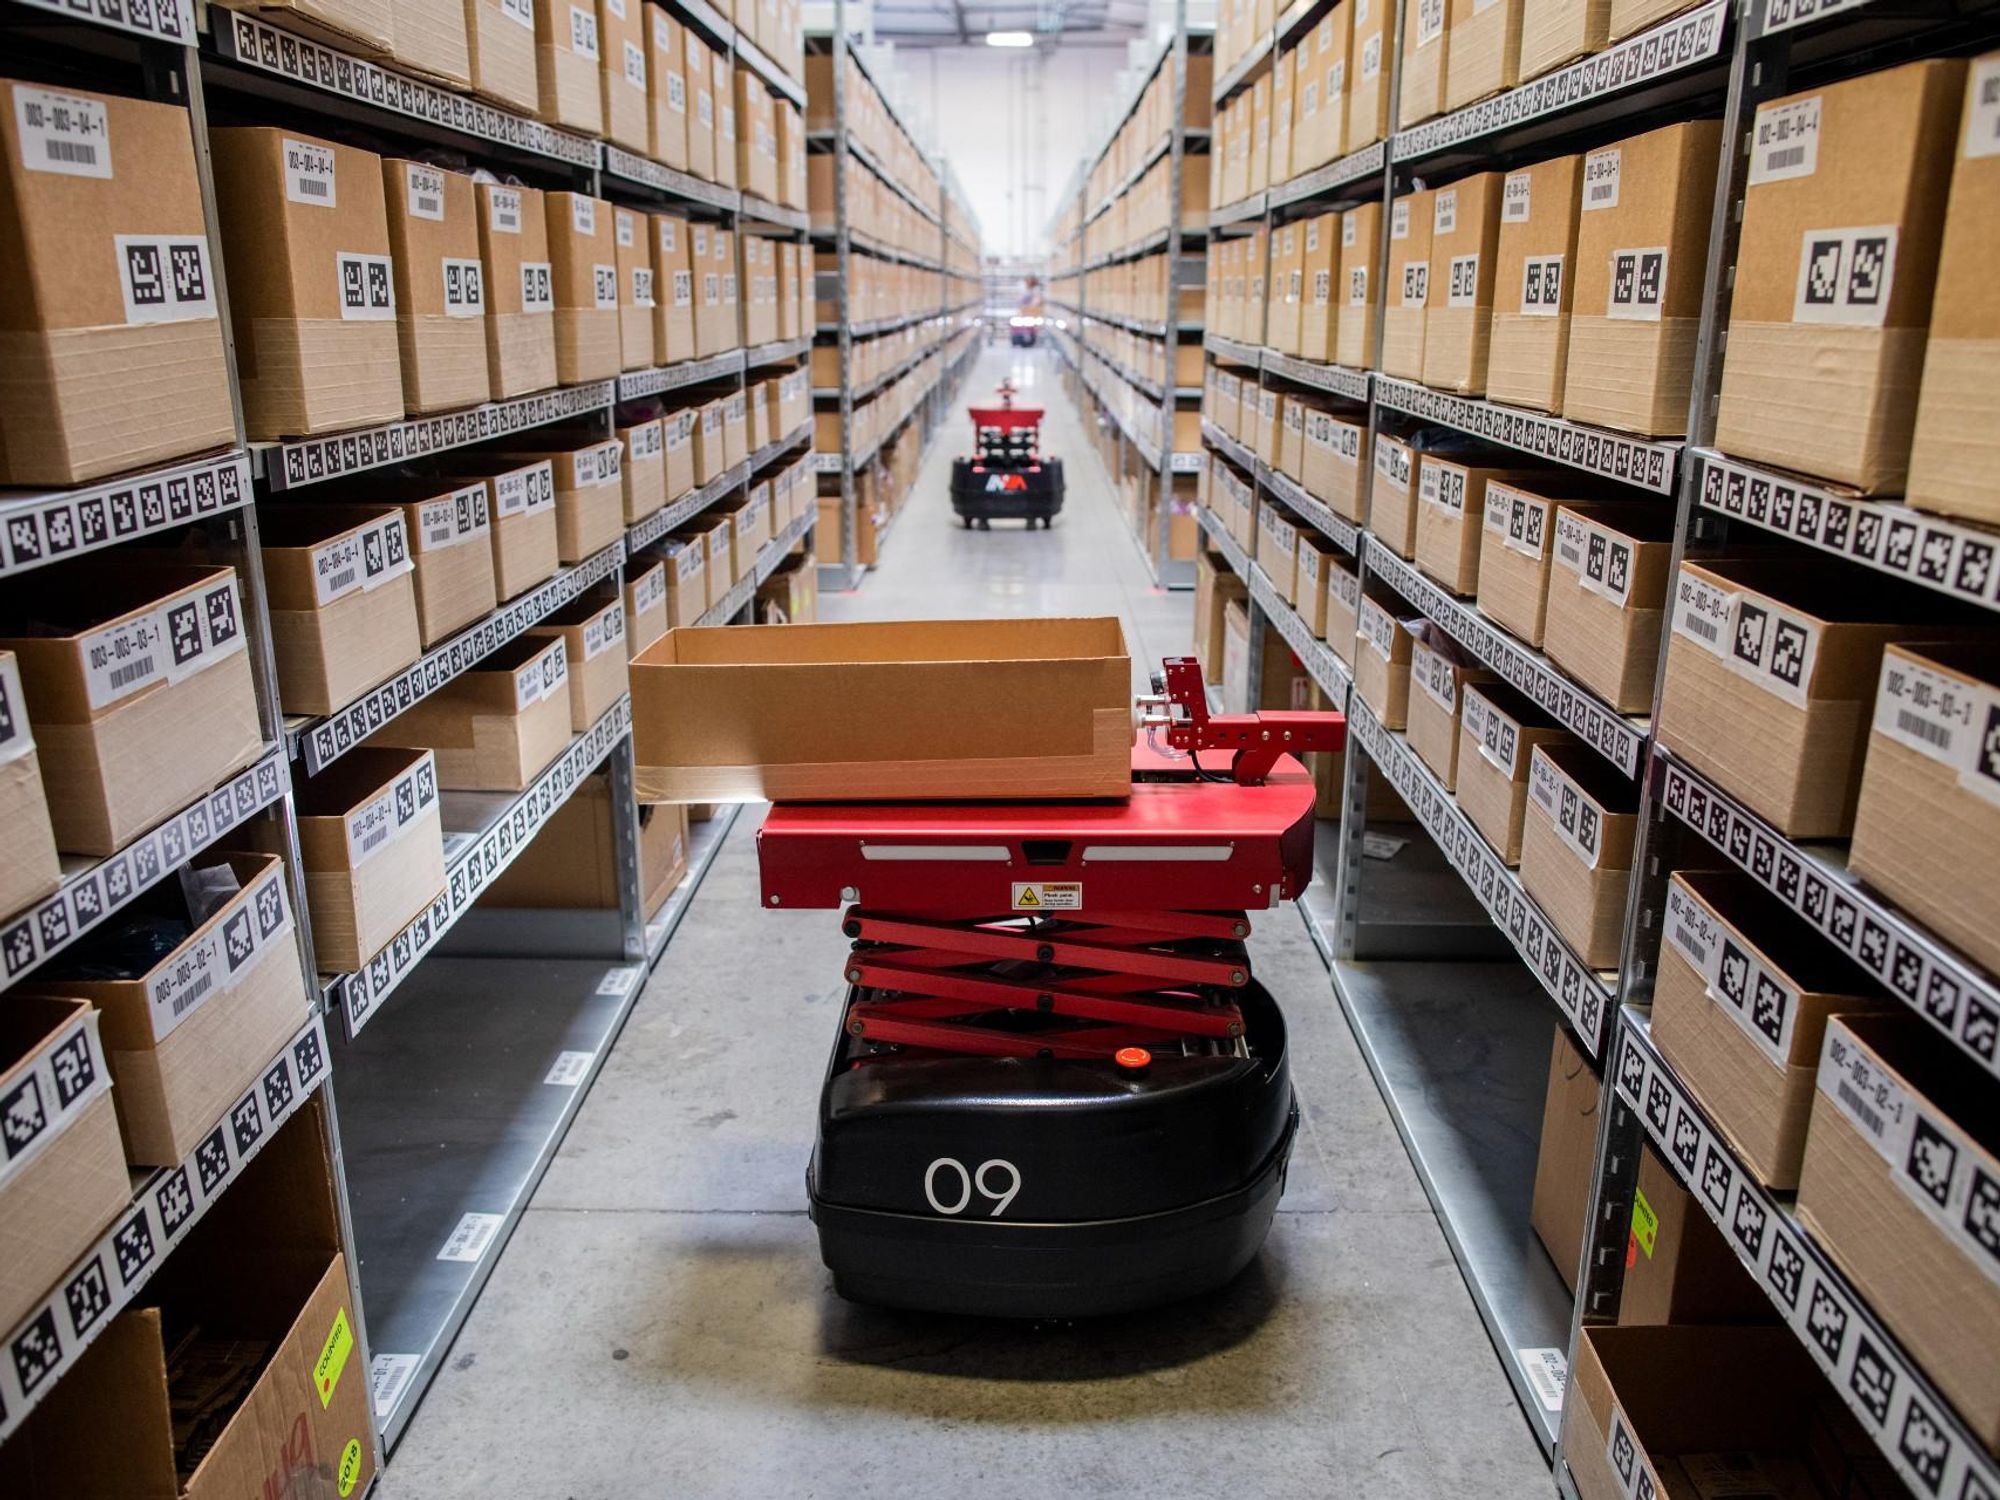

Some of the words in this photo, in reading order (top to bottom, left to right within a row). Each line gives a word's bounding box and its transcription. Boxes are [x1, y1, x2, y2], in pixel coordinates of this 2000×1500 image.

[24, 101, 105, 137] 003-003-04-1
[1680, 582, 1730, 624] 002-003-03-4
[90, 623, 161, 670] 003-003-03-1
[1887, 669, 1972, 726] 002-003-03-1
[1670, 892, 1717, 950] 002-003-02-4
[155, 940, 217, 1004] 003-003-02-1
[1830, 1037, 1903, 1125] 002-003-02-1
[924, 1157, 1022, 1217] 09
[319, 1323, 343, 1377] COUNTED
[340, 1443, 358, 1491] 2018
